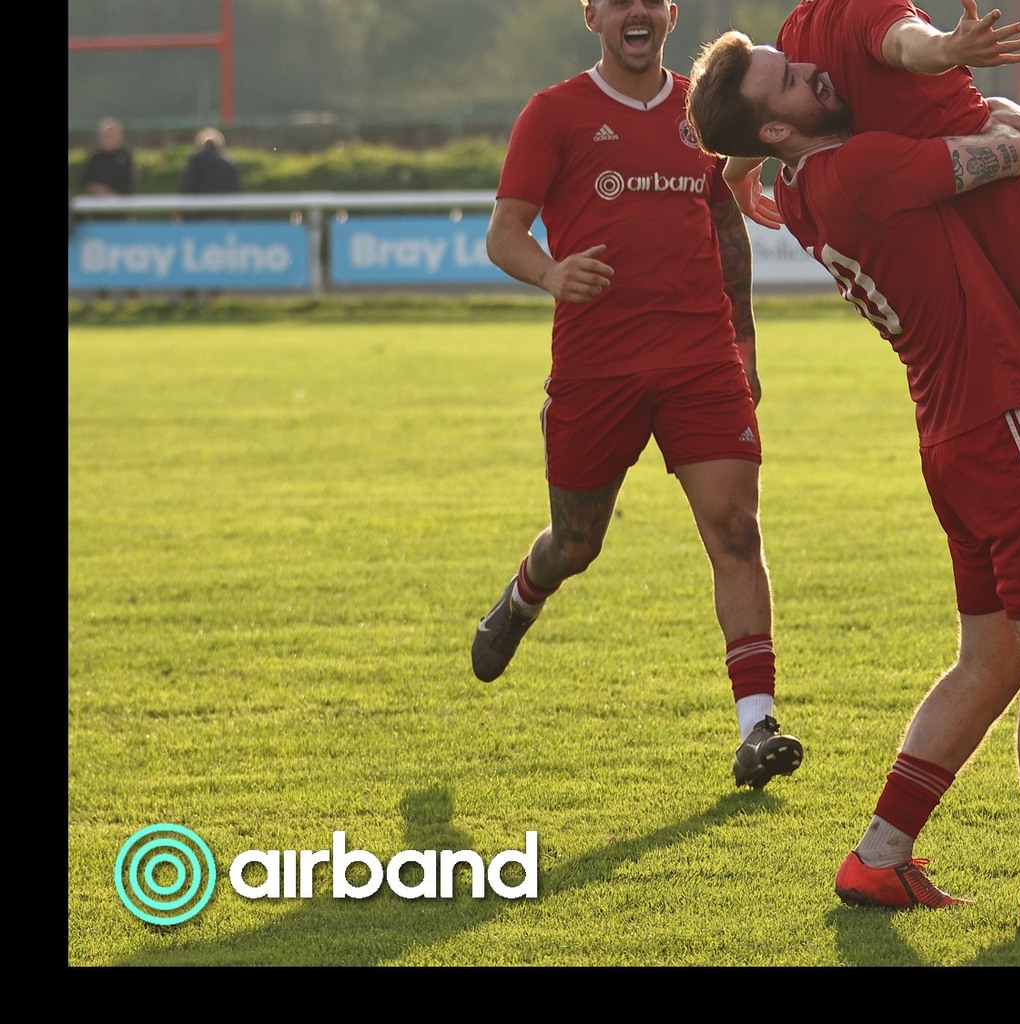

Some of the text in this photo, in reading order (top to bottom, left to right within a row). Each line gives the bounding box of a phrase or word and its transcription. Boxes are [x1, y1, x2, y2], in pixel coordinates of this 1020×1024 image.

[79, 232, 291, 278] Bray Leino
[350, 233, 448, 273] Bray
